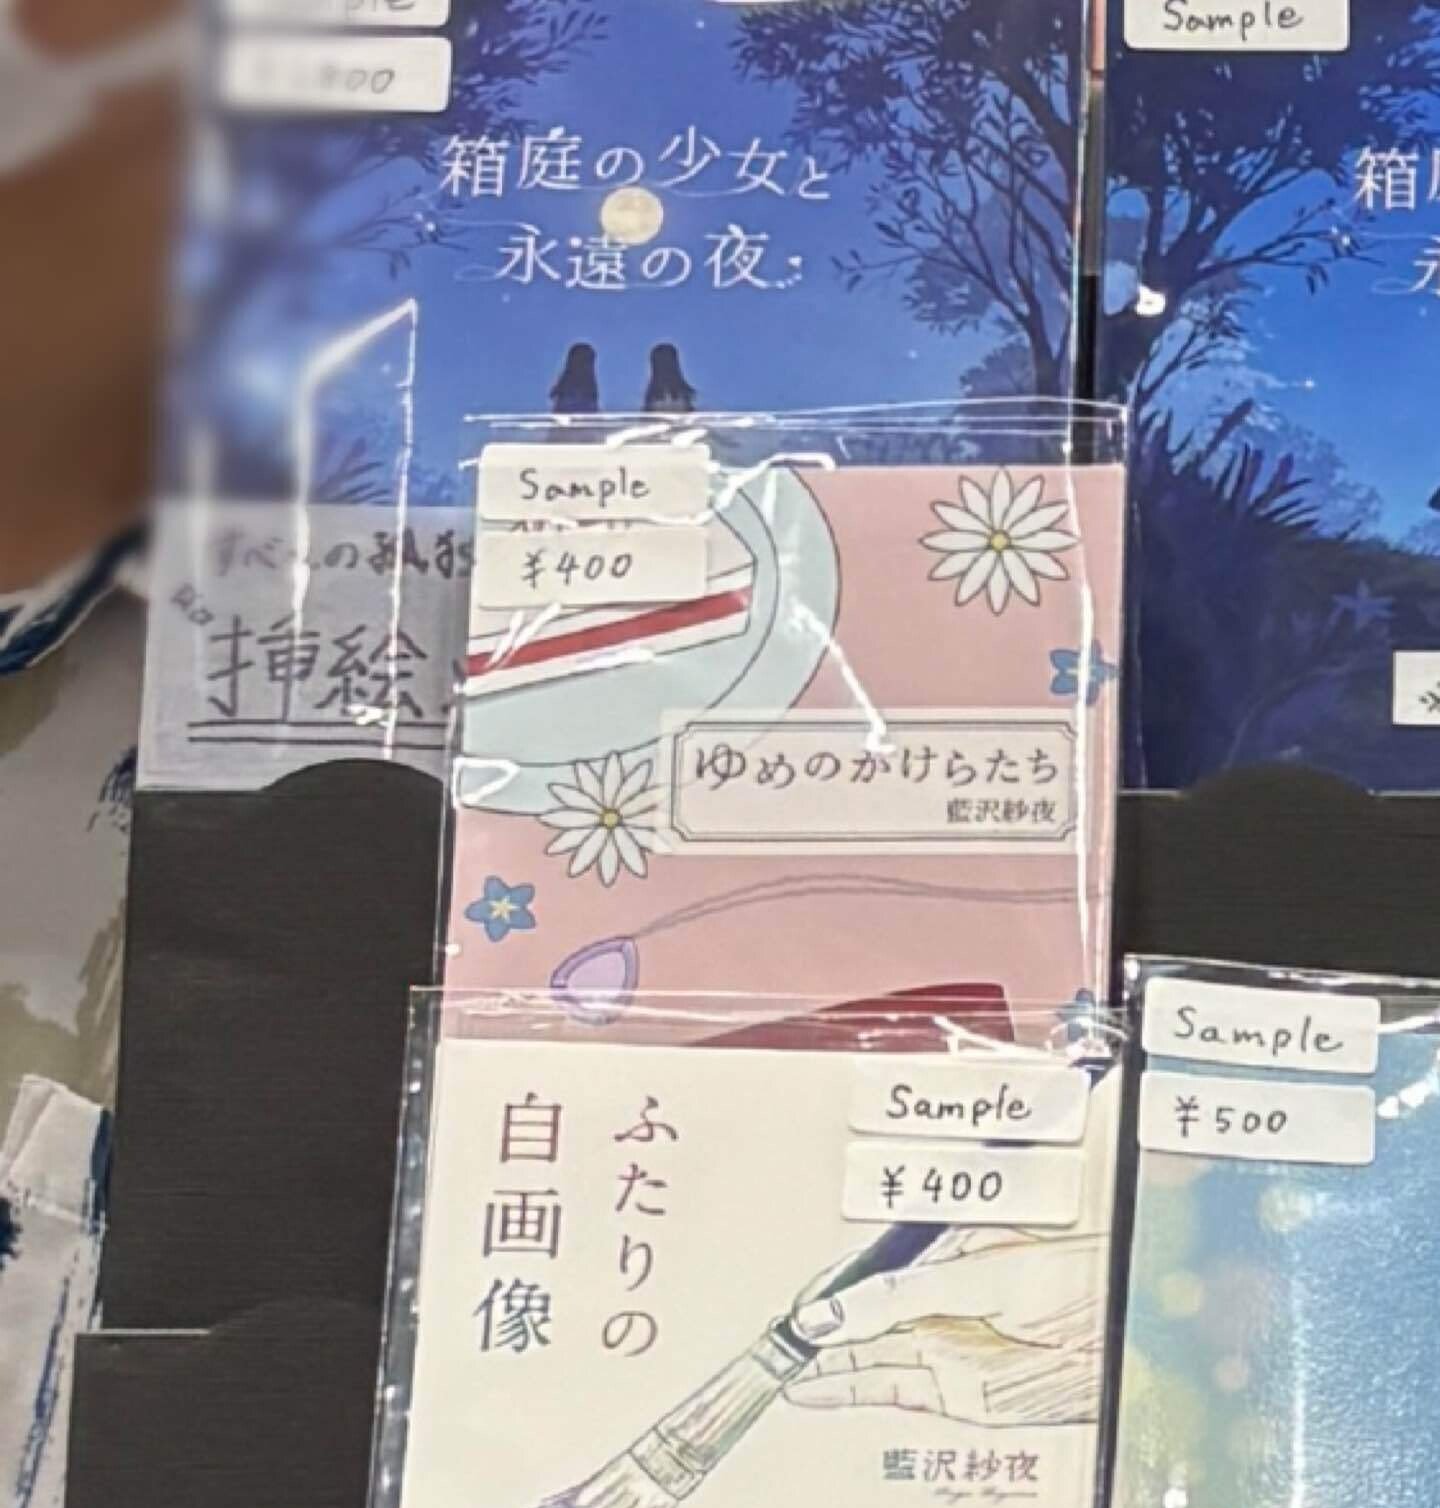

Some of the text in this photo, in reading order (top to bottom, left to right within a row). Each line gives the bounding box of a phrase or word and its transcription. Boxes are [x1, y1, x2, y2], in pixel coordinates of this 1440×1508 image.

[440, 127, 831, 200] 箱庭の少女と
[497, 223, 769, 290] 永遠の夜
[521, 468, 651, 507] Sample
[521, 551, 635, 588] ¥400
[695, 741, 1060, 792] ゆめのかけらたち
[946, 797, 1058, 827] 藍沢紗夜
[1174, 1006, 1343, 1056] Sample
[886, 1082, 1034, 1126] Sample
[1174, 1095, 1288, 1139] ¥500
[881, 1165, 1004, 1211] ¥400
[474, 1091, 563, 1353] 自画像
[602, 1097, 680, 1357] ふたりの
[882, 1447, 1040, 1482] 藍沢紗夜
